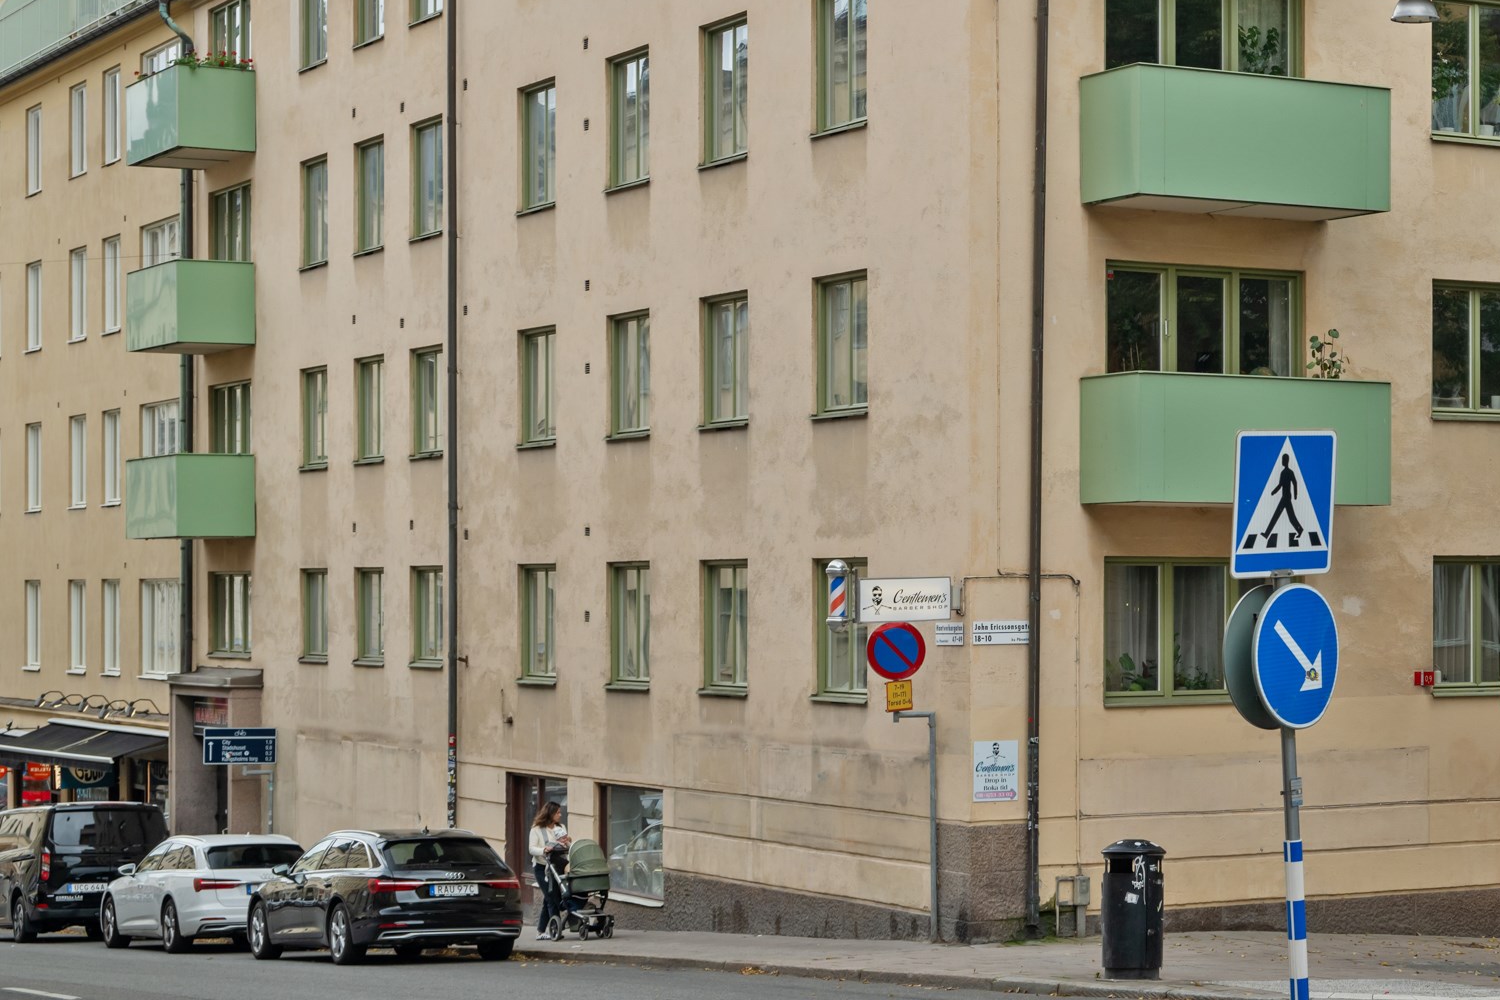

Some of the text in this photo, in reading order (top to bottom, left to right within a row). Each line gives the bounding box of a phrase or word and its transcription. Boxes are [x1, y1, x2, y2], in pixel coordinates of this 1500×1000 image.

[893, 588, 948, 604] Gentlemen's
[974, 622, 989, 631] John
[437, 884, 475, 893] RAU 97C
